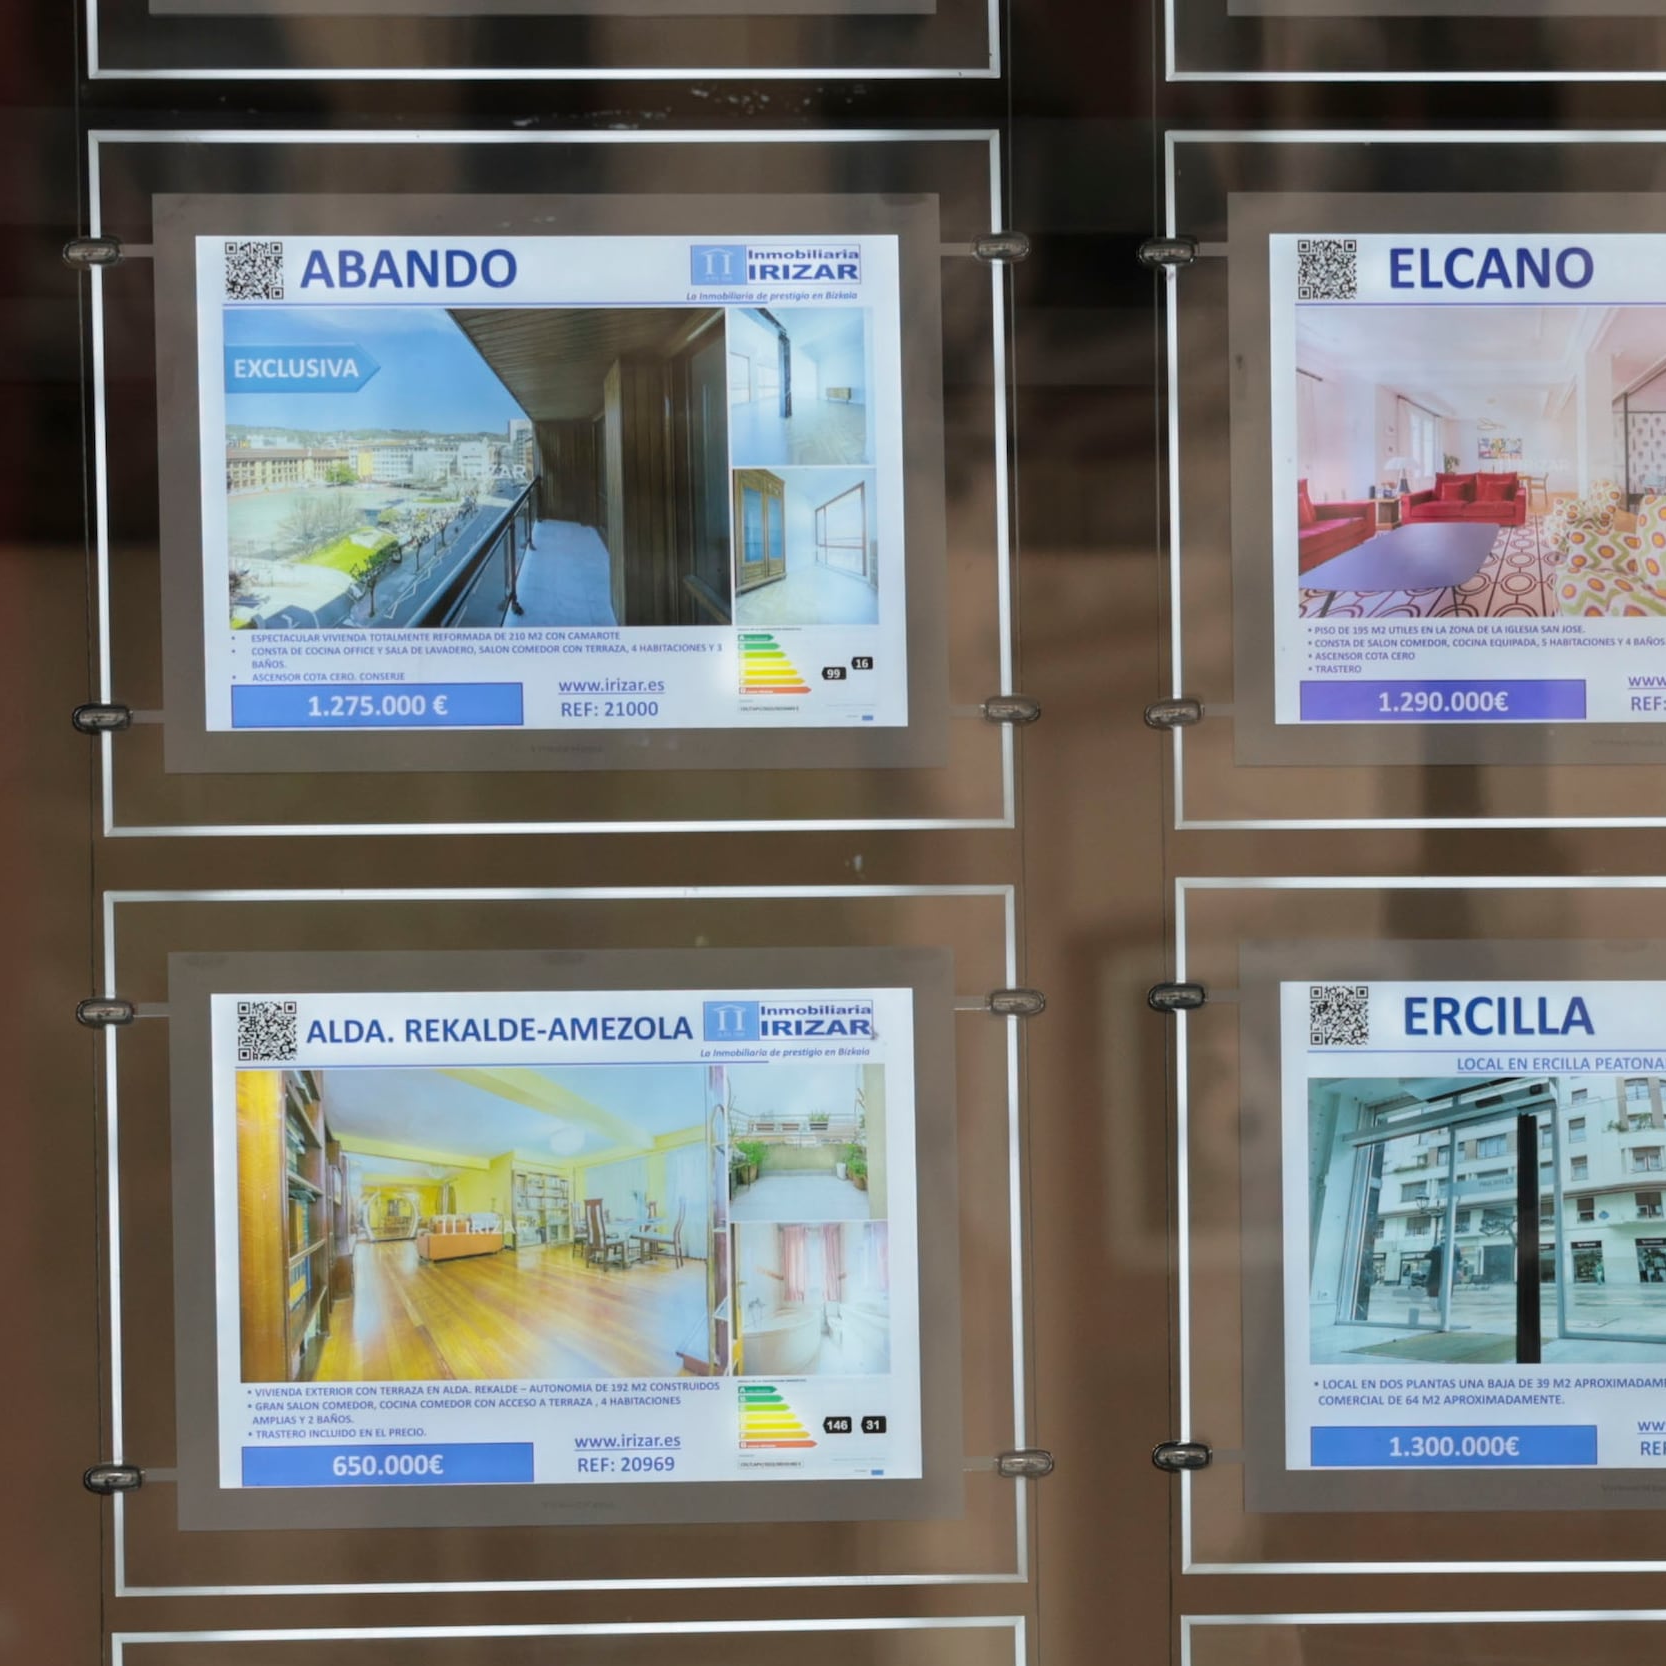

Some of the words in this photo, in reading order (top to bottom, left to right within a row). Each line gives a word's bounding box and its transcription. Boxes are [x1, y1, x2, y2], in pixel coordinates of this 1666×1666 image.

[747, 248, 859, 260] Inmobiliaria
[299, 248, 517, 290] ABANDO
[748, 263, 858, 280] IRIZAR
[1389, 245, 1594, 290] ELCANO
[234, 357, 359, 378] EXCLUSIVA
[1314, 625, 1336, 636] PISO
[1338, 625, 1349, 636] DE
[1352, 625, 1369, 636] 195
[1371, 625, 1386, 636] M2
[1388, 625, 1419, 636] UTILES
[1421, 625, 1434, 636] EN
[1435, 625, 1447, 636] LA
[1448, 625, 1475, 636] ZONA
[1477, 625, 1488, 635] DE
[1491, 625, 1502, 635] LA
[1504, 625, 1539, 635] IGLESIA
[1541, 625, 1559, 635] SAN
[1561, 625, 1585, 635] JOSE.
[558, 676, 665, 692] www.irizar.es
[308, 694, 426, 717] 1.275.000
[432, 694, 448, 716] €
[560, 701, 598, 717] REF:
[604, 700, 659, 717] 21000
[1378, 690, 1509, 712] 1.290.000€
[1630, 695, 1666, 711] REF:
[760, 1004, 872, 1016] Inmobiliaria
[1404, 995, 1595, 1036] ERCILLA
[305, 1018, 394, 1044] ALDA.
[405, 1015, 694, 1043] REKALDE-AMEZOLA
[761, 1020, 872, 1036] IRIZAR
[1457, 1057, 1504, 1071] LOCAL
[1508, 1057, 1527, 1071] EN
[1533, 1057, 1590, 1070] ERCILLA
[573, 1432, 681, 1448] www.irizar.es
[1389, 1435, 1520, 1457] 1.300.000€
[332, 1453, 444, 1476] 650.000€
[577, 1456, 615, 1473] REF:
[620, 1455, 675, 1472] 20969
